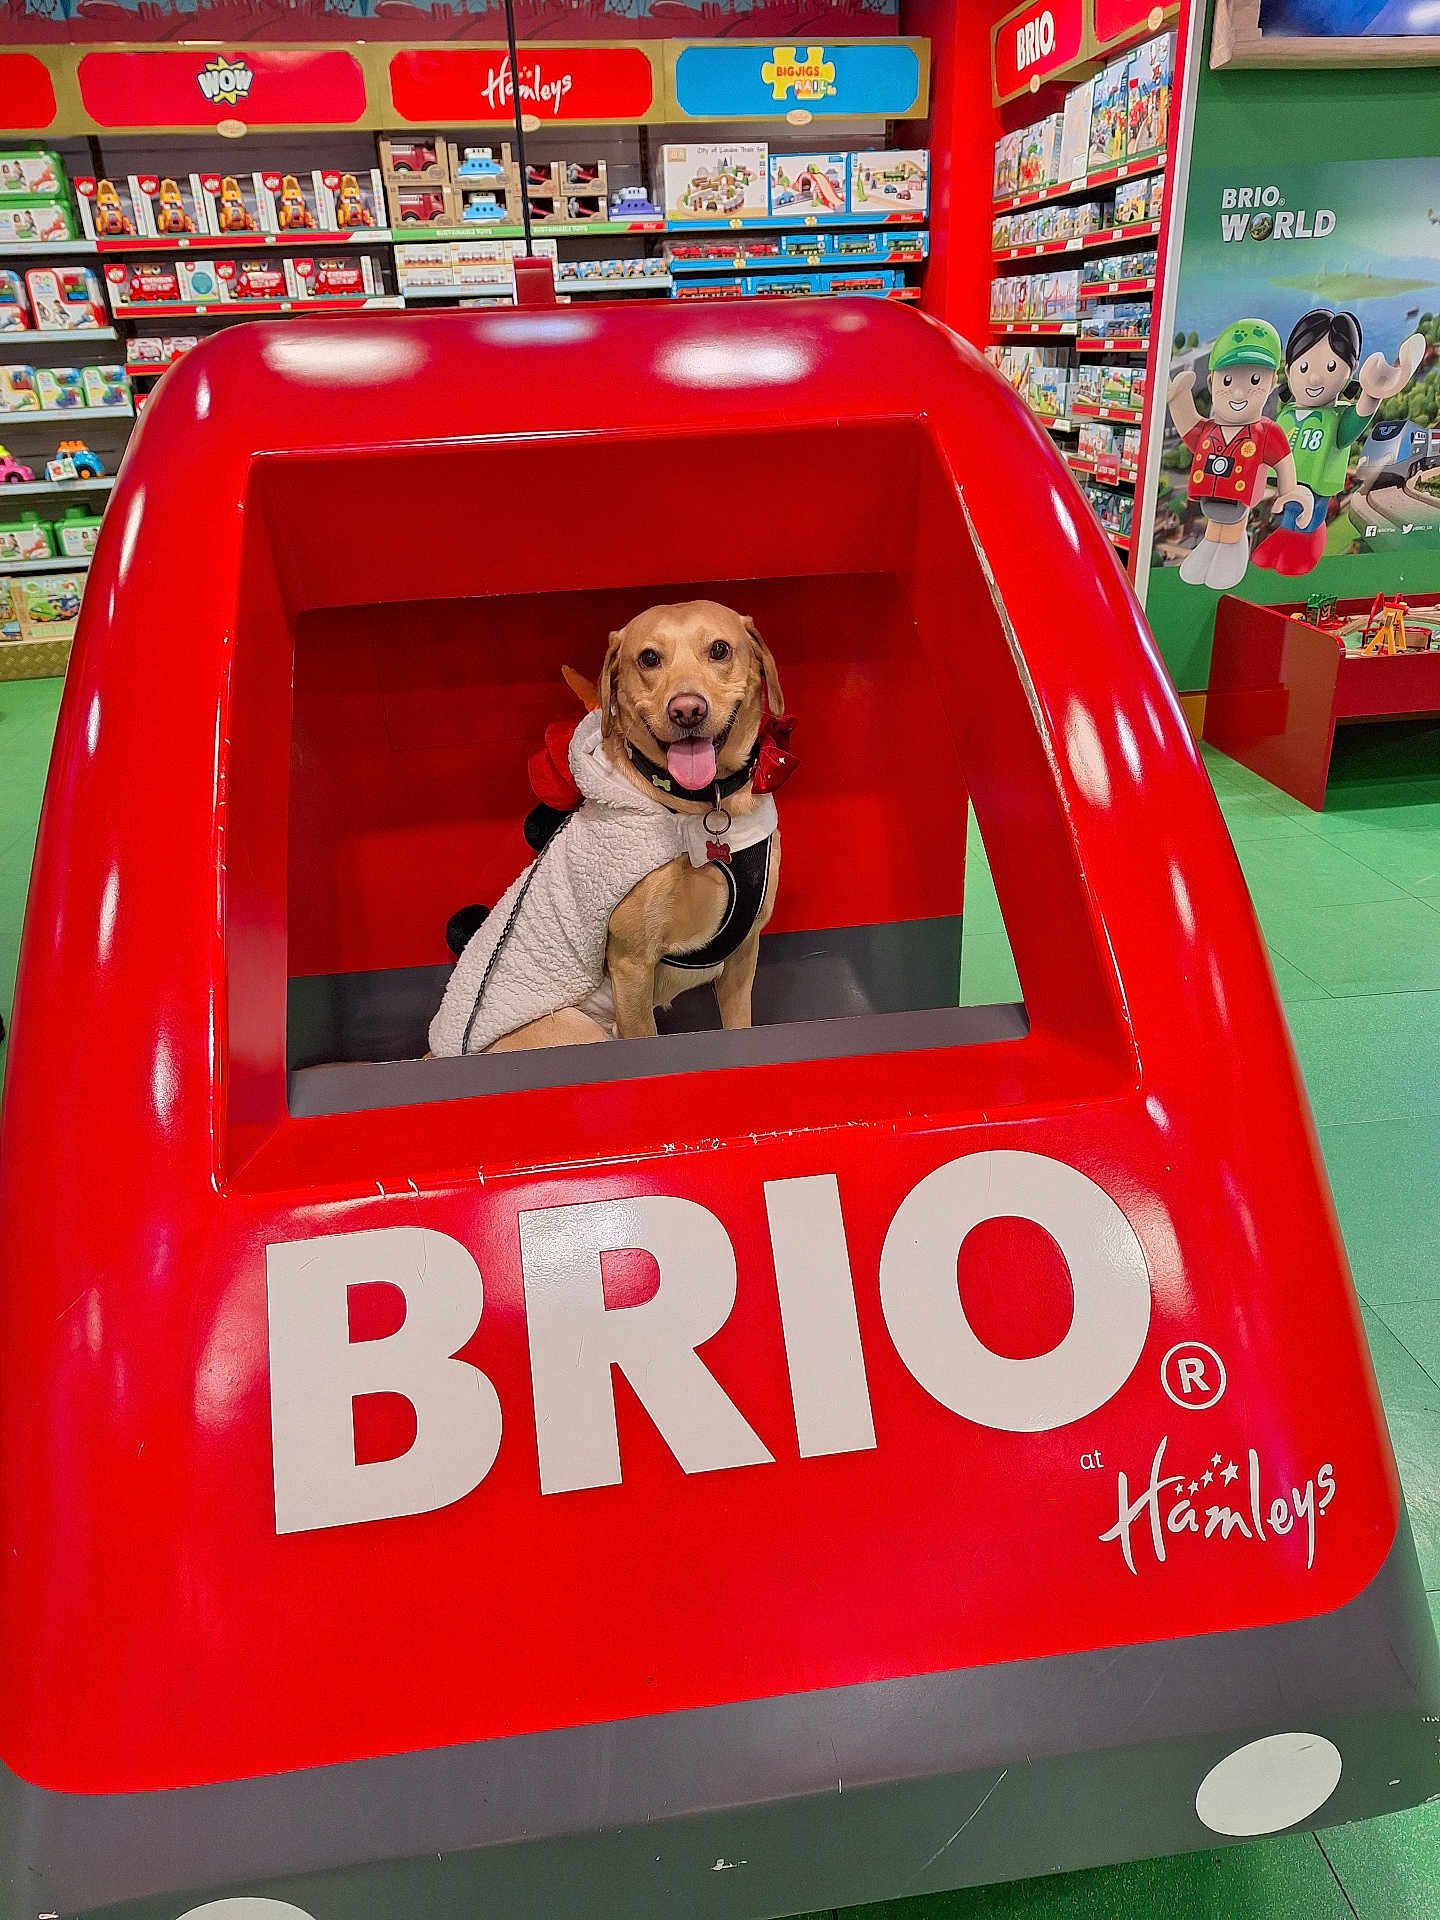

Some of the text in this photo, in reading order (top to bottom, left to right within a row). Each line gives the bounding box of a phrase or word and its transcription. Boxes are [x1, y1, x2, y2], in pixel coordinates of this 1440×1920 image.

[1016, 10, 1055, 71] BRIO
[197, 69, 254, 99] WOW
[481, 56, 573, 115] Hamleys
[776, 65, 820, 77] BIGJIGS
[1221, 185, 1280, 209] BRIO
[1220, 209, 1337, 243] WORLD
[1301, 428, 1324, 451] 18
[265, 1149, 1152, 1535] BRIO
[1079, 1448, 1105, 1471] at
[1098, 1435, 1336, 1576] Hamleys
